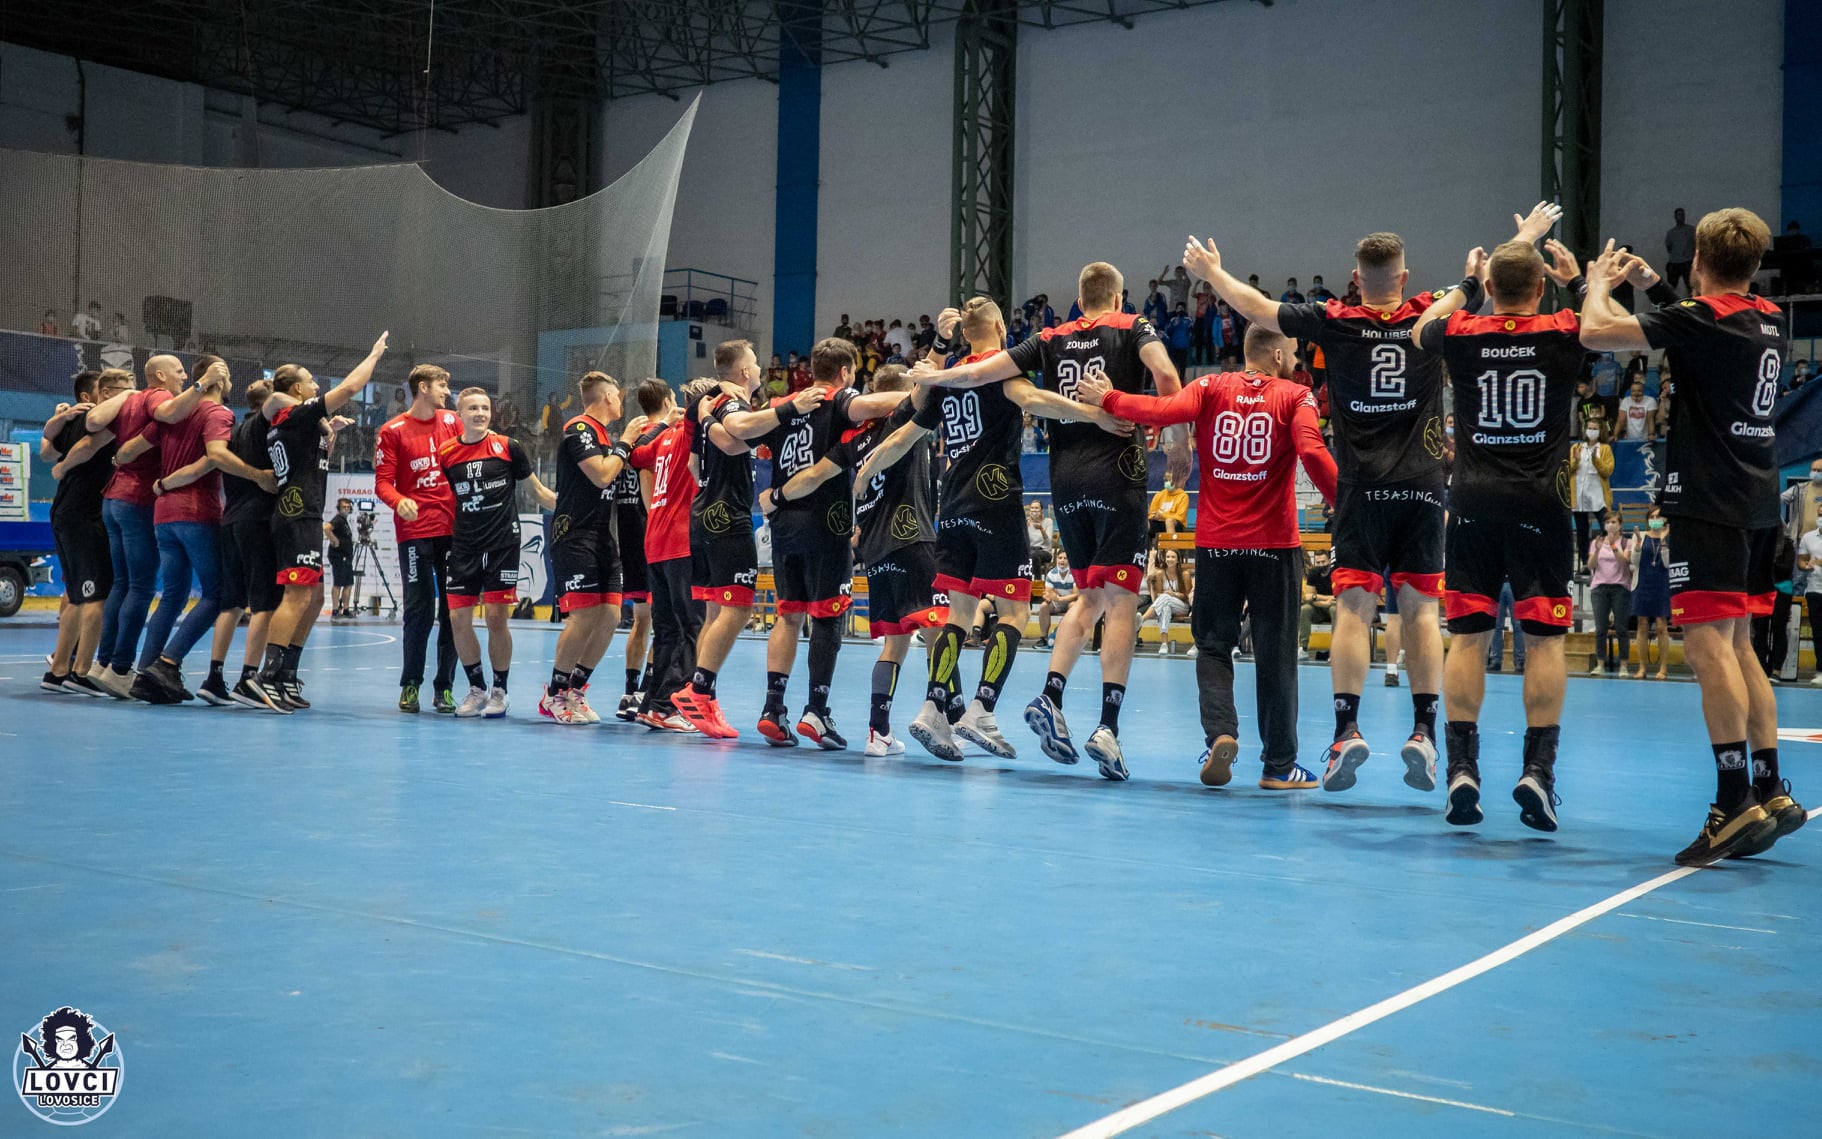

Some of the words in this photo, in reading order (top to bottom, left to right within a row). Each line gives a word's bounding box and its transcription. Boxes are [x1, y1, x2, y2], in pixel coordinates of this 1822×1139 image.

[1371, 343, 1406, 397] 2
[1481, 346, 1536, 358] BOUČEK
[1477, 369, 1546, 428] 10
[1752, 348, 1780, 416] 8
[942, 390, 984, 445] 29
[1350, 400, 1417, 413] Glanzstoff
[780, 423, 814, 477] 42
[1213, 411, 1273, 465] 88
[1472, 430, 1546, 444] Glanzstoff
[466, 461, 482, 478] 17
[1213, 468, 1267, 481] Glanzstoff
[408, 546, 419, 583] Kempa
